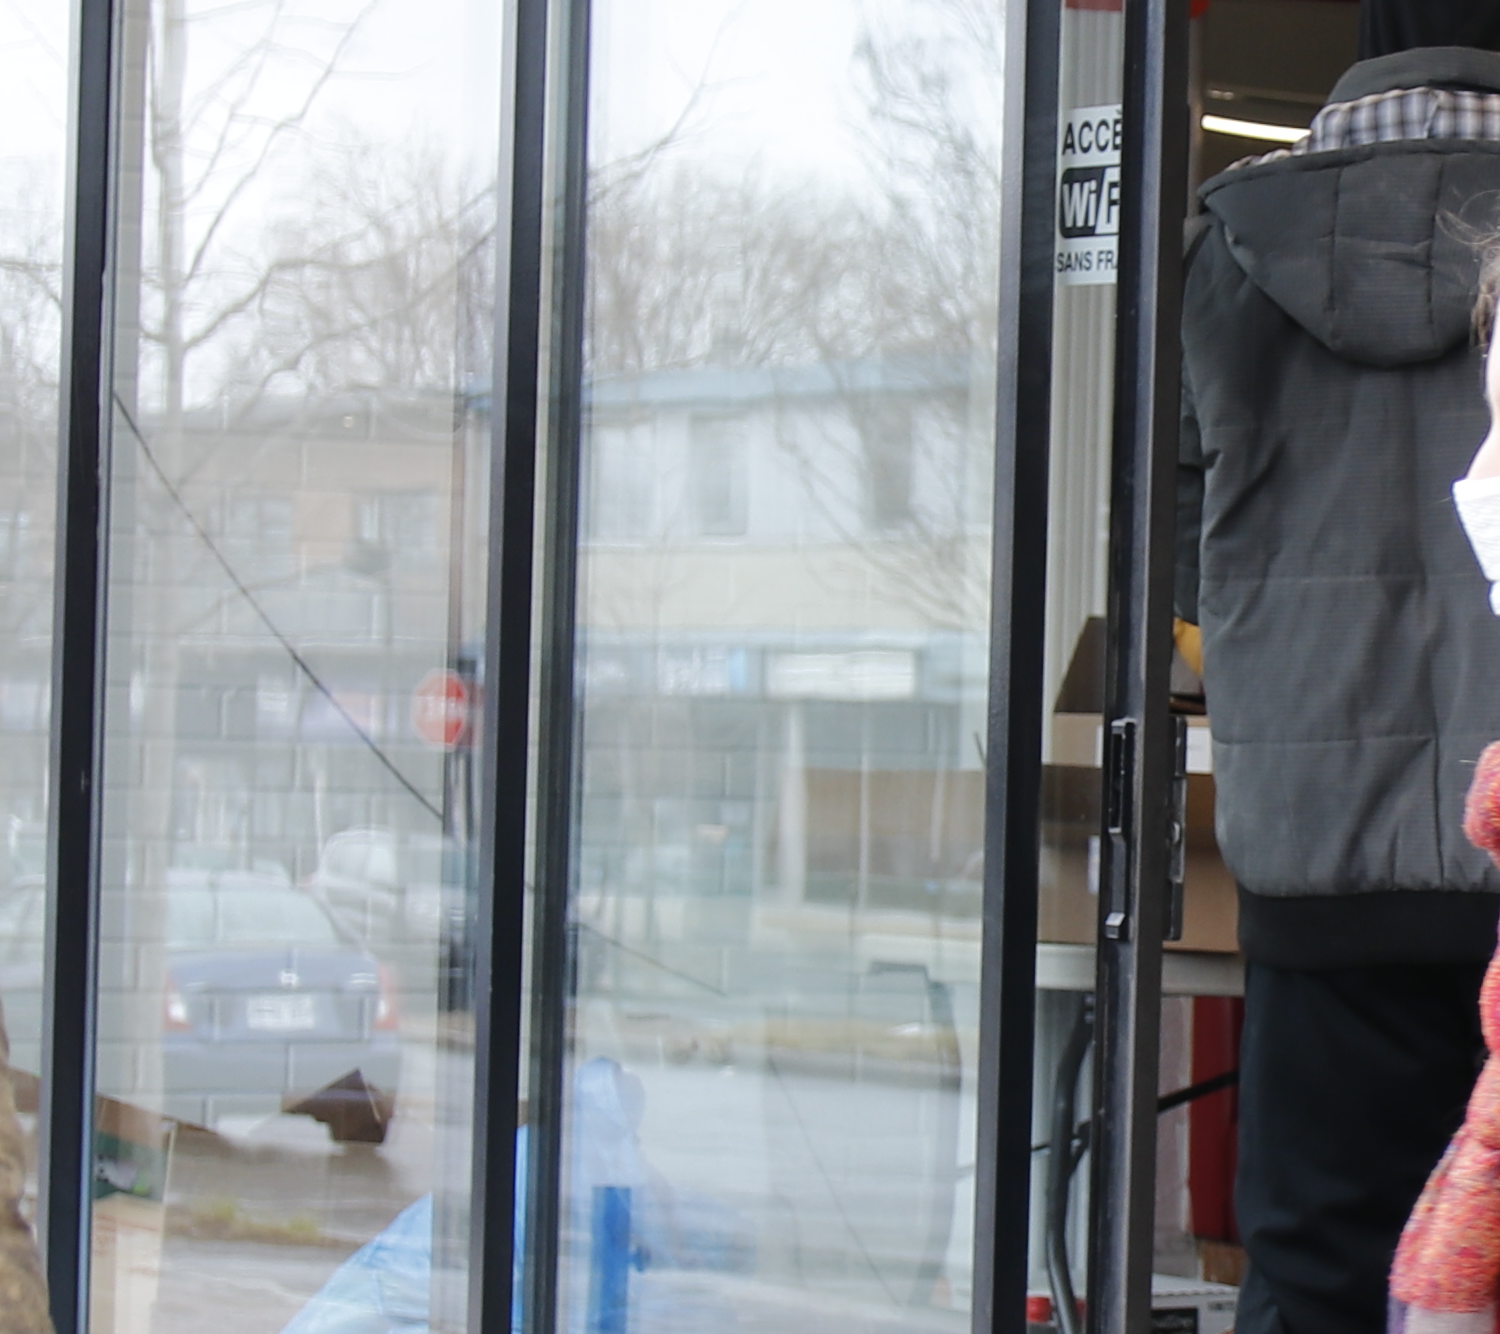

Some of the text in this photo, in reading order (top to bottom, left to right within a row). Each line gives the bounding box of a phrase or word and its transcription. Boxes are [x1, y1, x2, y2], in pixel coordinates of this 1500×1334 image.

[1062, 109, 1122, 155] ACCÈ
[1062, 178, 1120, 228] WiF
[1057, 249, 1117, 272] SANS FR
